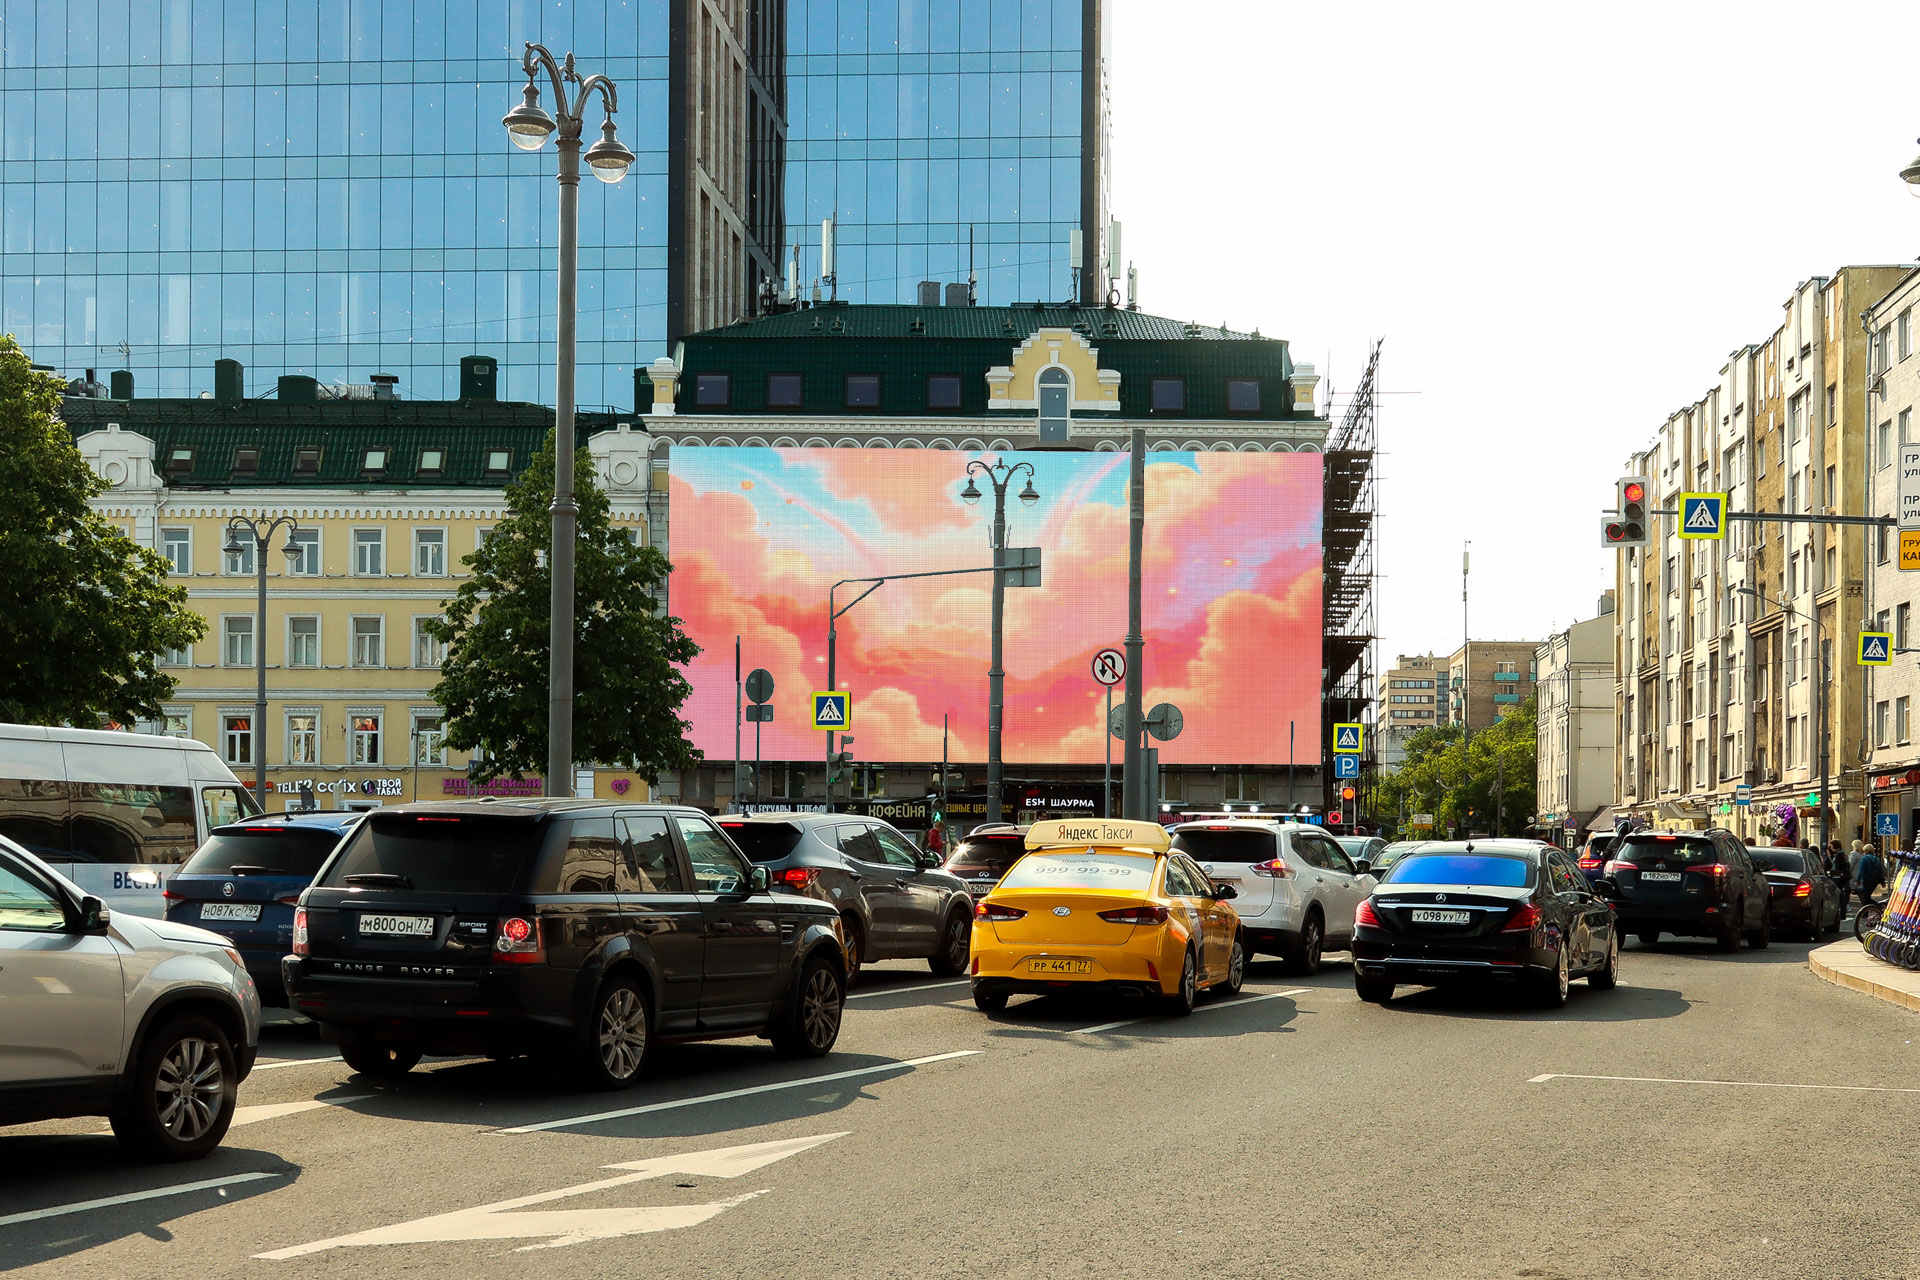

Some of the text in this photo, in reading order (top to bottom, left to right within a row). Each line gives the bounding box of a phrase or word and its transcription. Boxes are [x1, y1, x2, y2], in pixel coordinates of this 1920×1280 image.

[1904, 468, 1920, 479] ул
[376, 787, 402, 796] ТАБАК
[1025, 798, 1095, 807] ESH ШАУРМА
[868, 804, 926, 818] КОФЕЙНЯ
[1058, 824, 1133, 841] Яндекс Такси
[333, 962, 456, 976] RANGE ROVER
